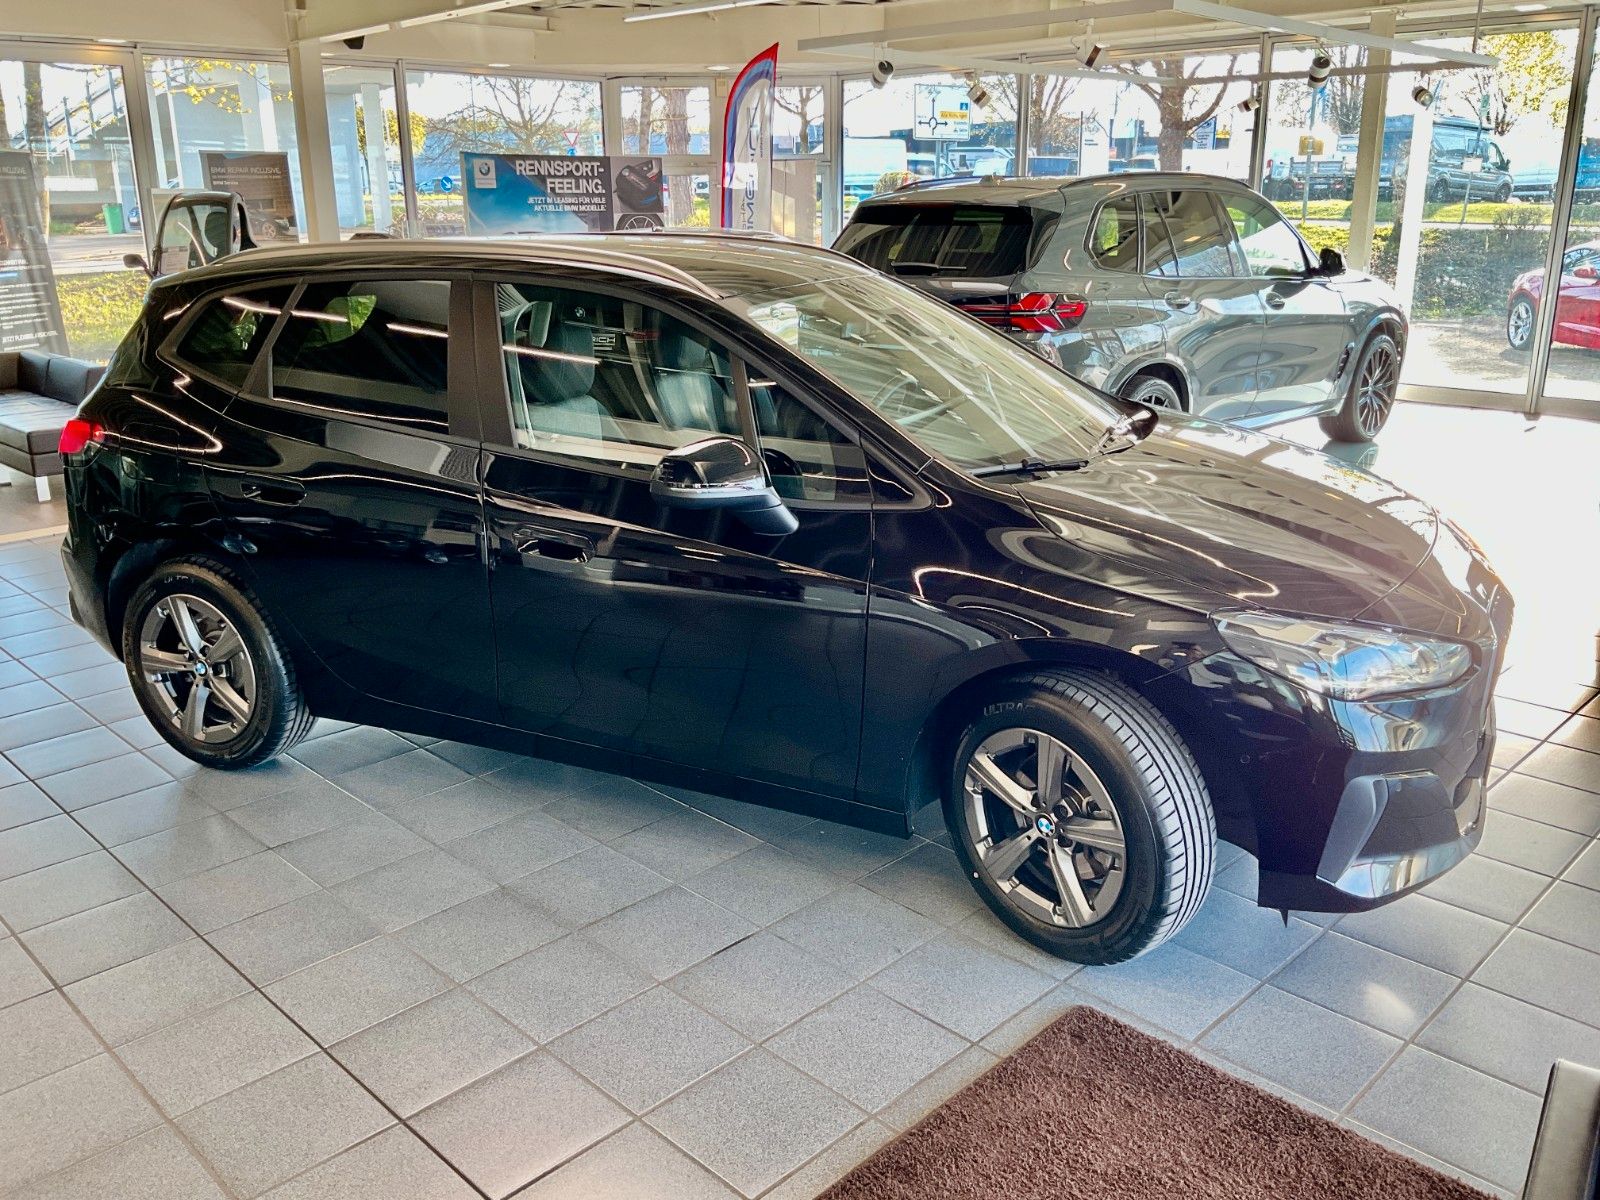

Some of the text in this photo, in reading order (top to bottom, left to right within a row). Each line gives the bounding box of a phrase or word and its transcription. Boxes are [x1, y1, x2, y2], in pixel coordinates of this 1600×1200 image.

[515, 160, 604, 176] RENNSPORT-
[547, 178, 606, 194] FEELING.
[579, 195, 591, 204] FÜR
[534, 204, 563, 212] AKTUELLE
[564, 204, 578, 212] BMW
